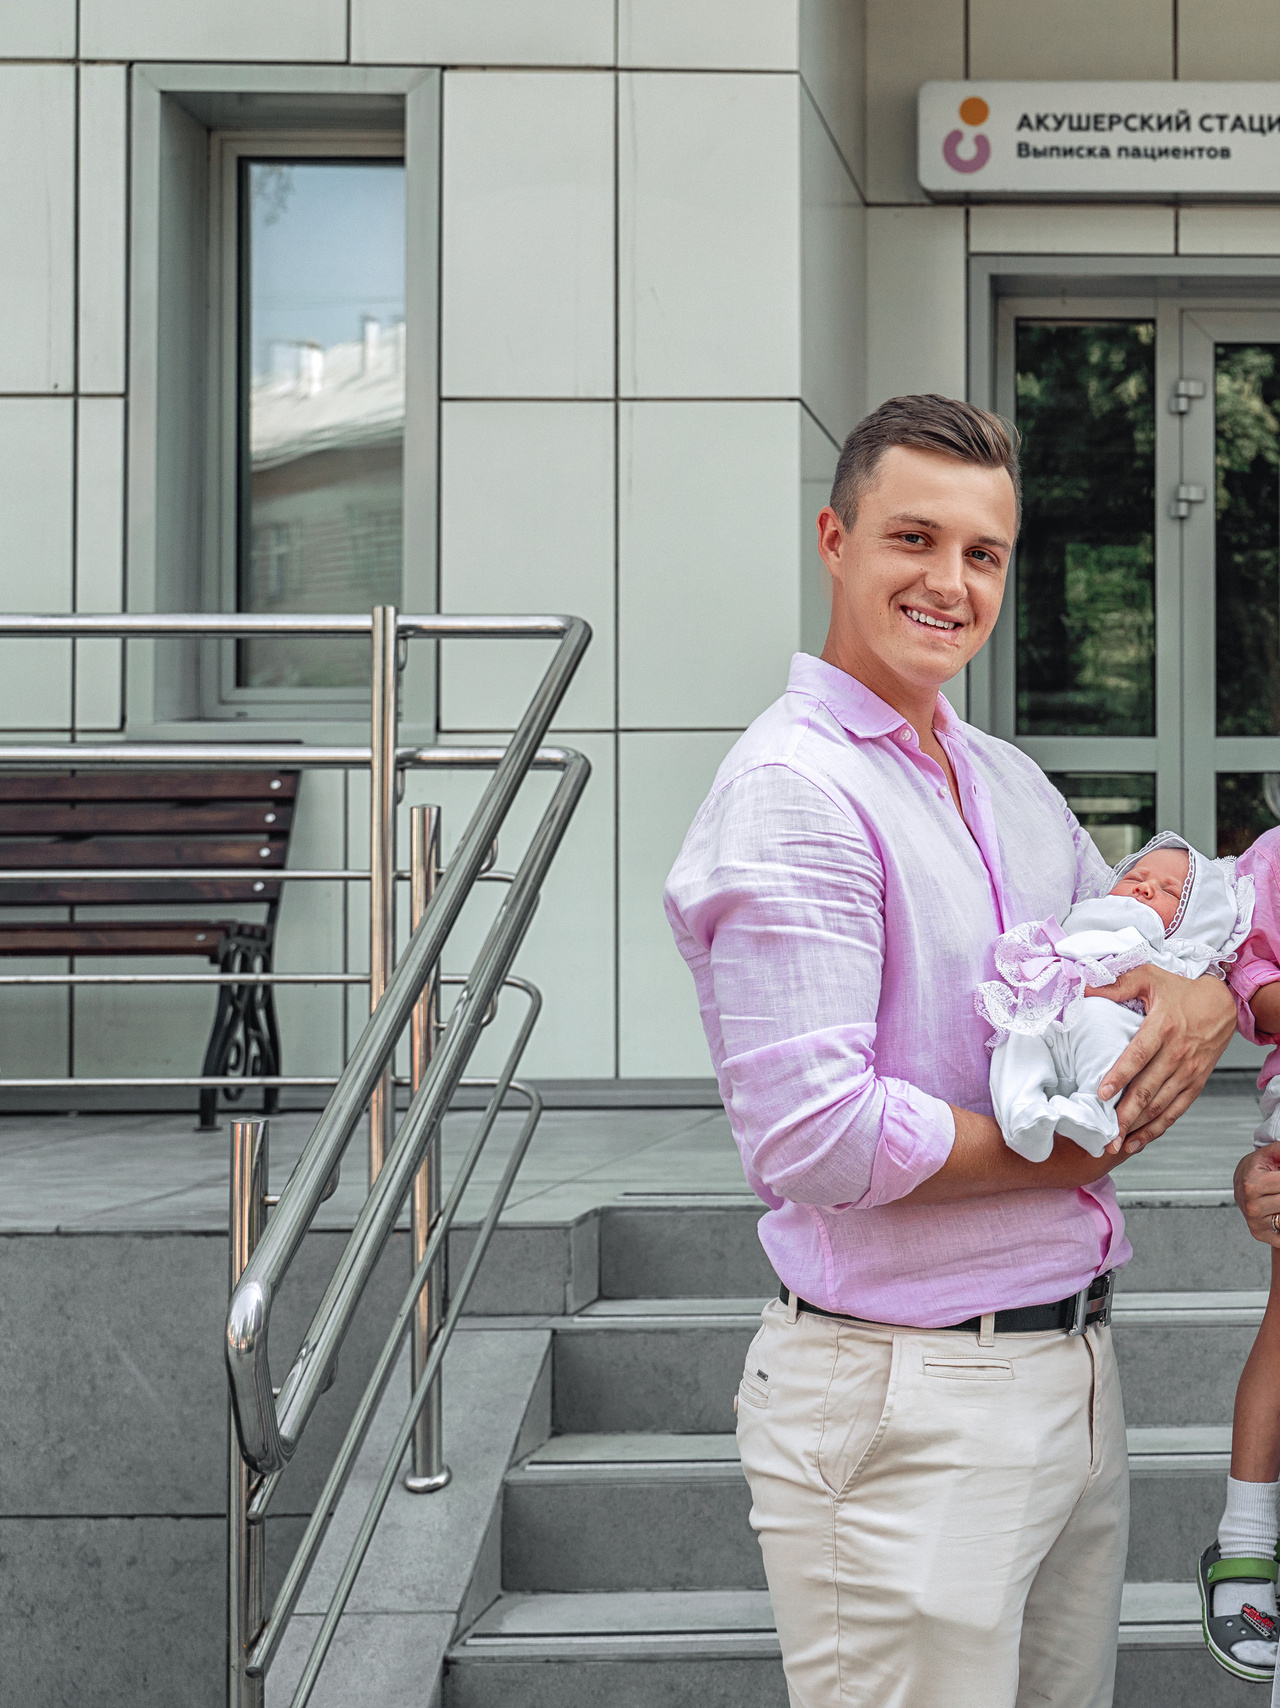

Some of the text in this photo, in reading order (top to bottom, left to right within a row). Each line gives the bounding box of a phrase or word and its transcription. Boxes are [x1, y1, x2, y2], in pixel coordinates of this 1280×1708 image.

[1016, 110, 1192, 133] АКУШЕРСКИЙ
[1016, 142, 1231, 162] Выписка пациентов
